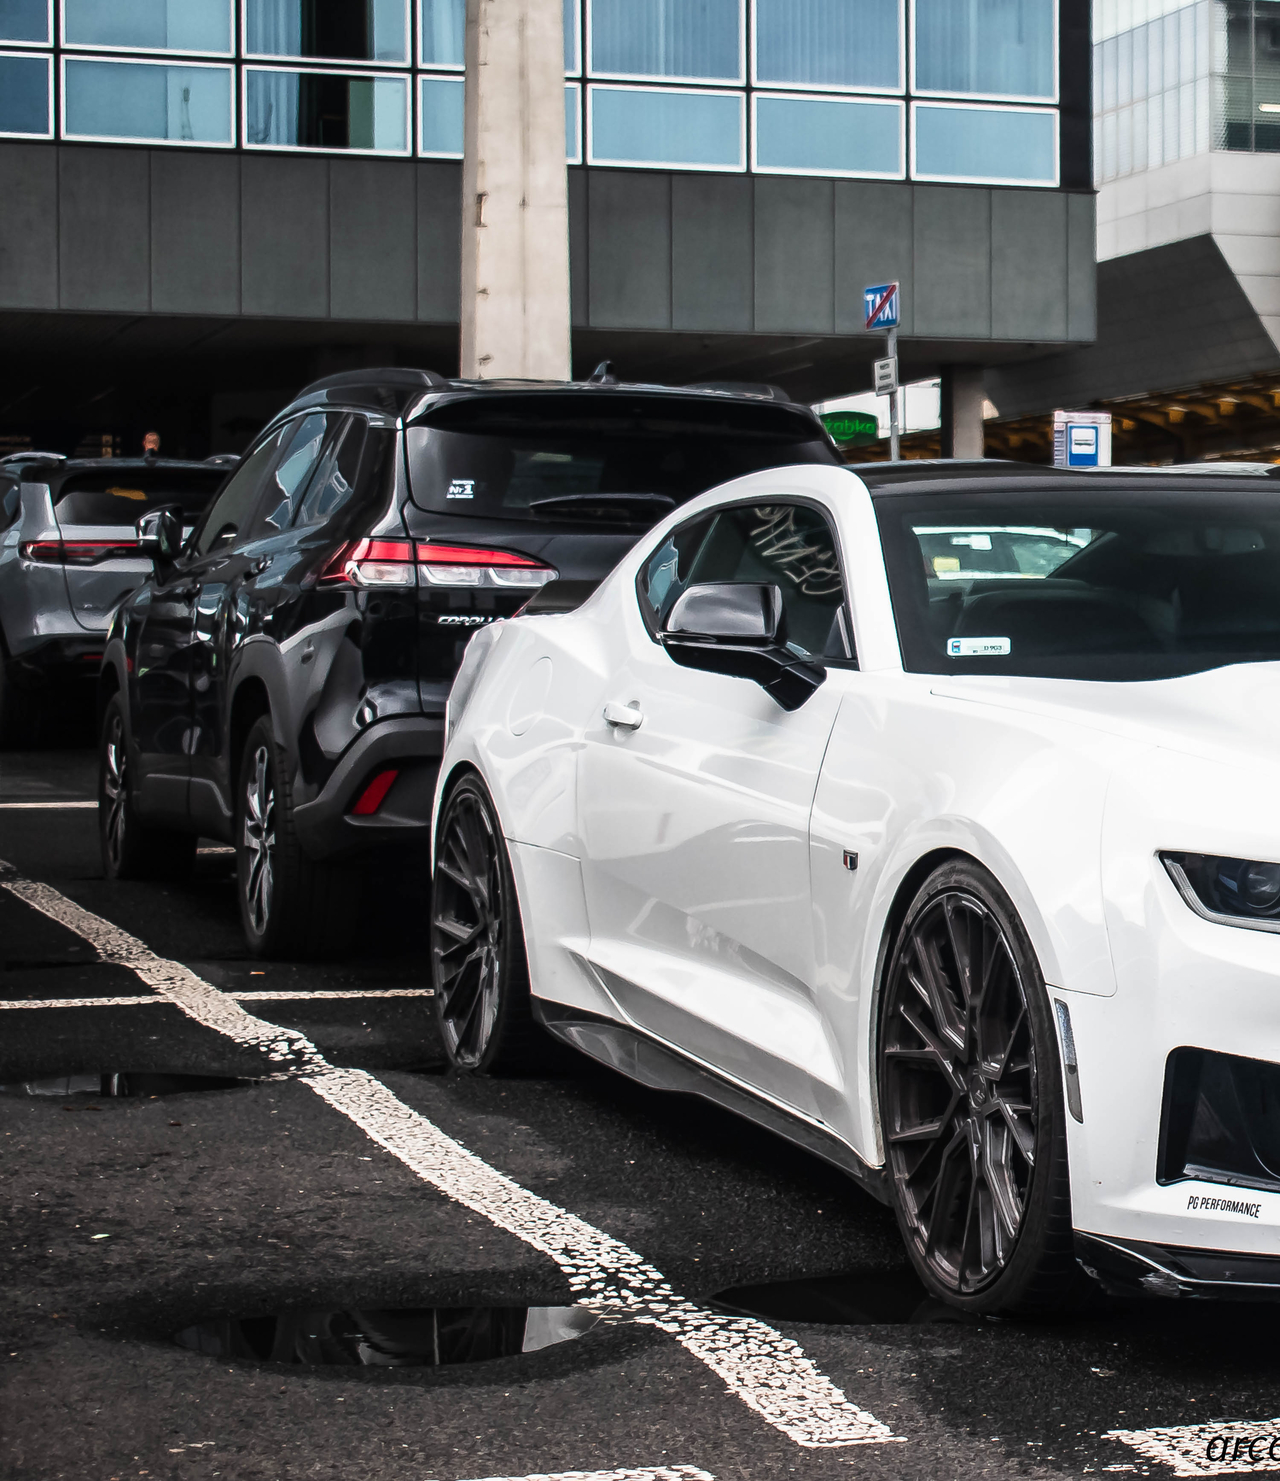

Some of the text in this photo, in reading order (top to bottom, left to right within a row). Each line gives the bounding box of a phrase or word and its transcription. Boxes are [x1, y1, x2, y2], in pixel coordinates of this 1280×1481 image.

[865, 291, 897, 322] TAXI
[824, 419, 876, 434] żabka
[1187, 1195, 1262, 1219] PG PERFORMANCE
